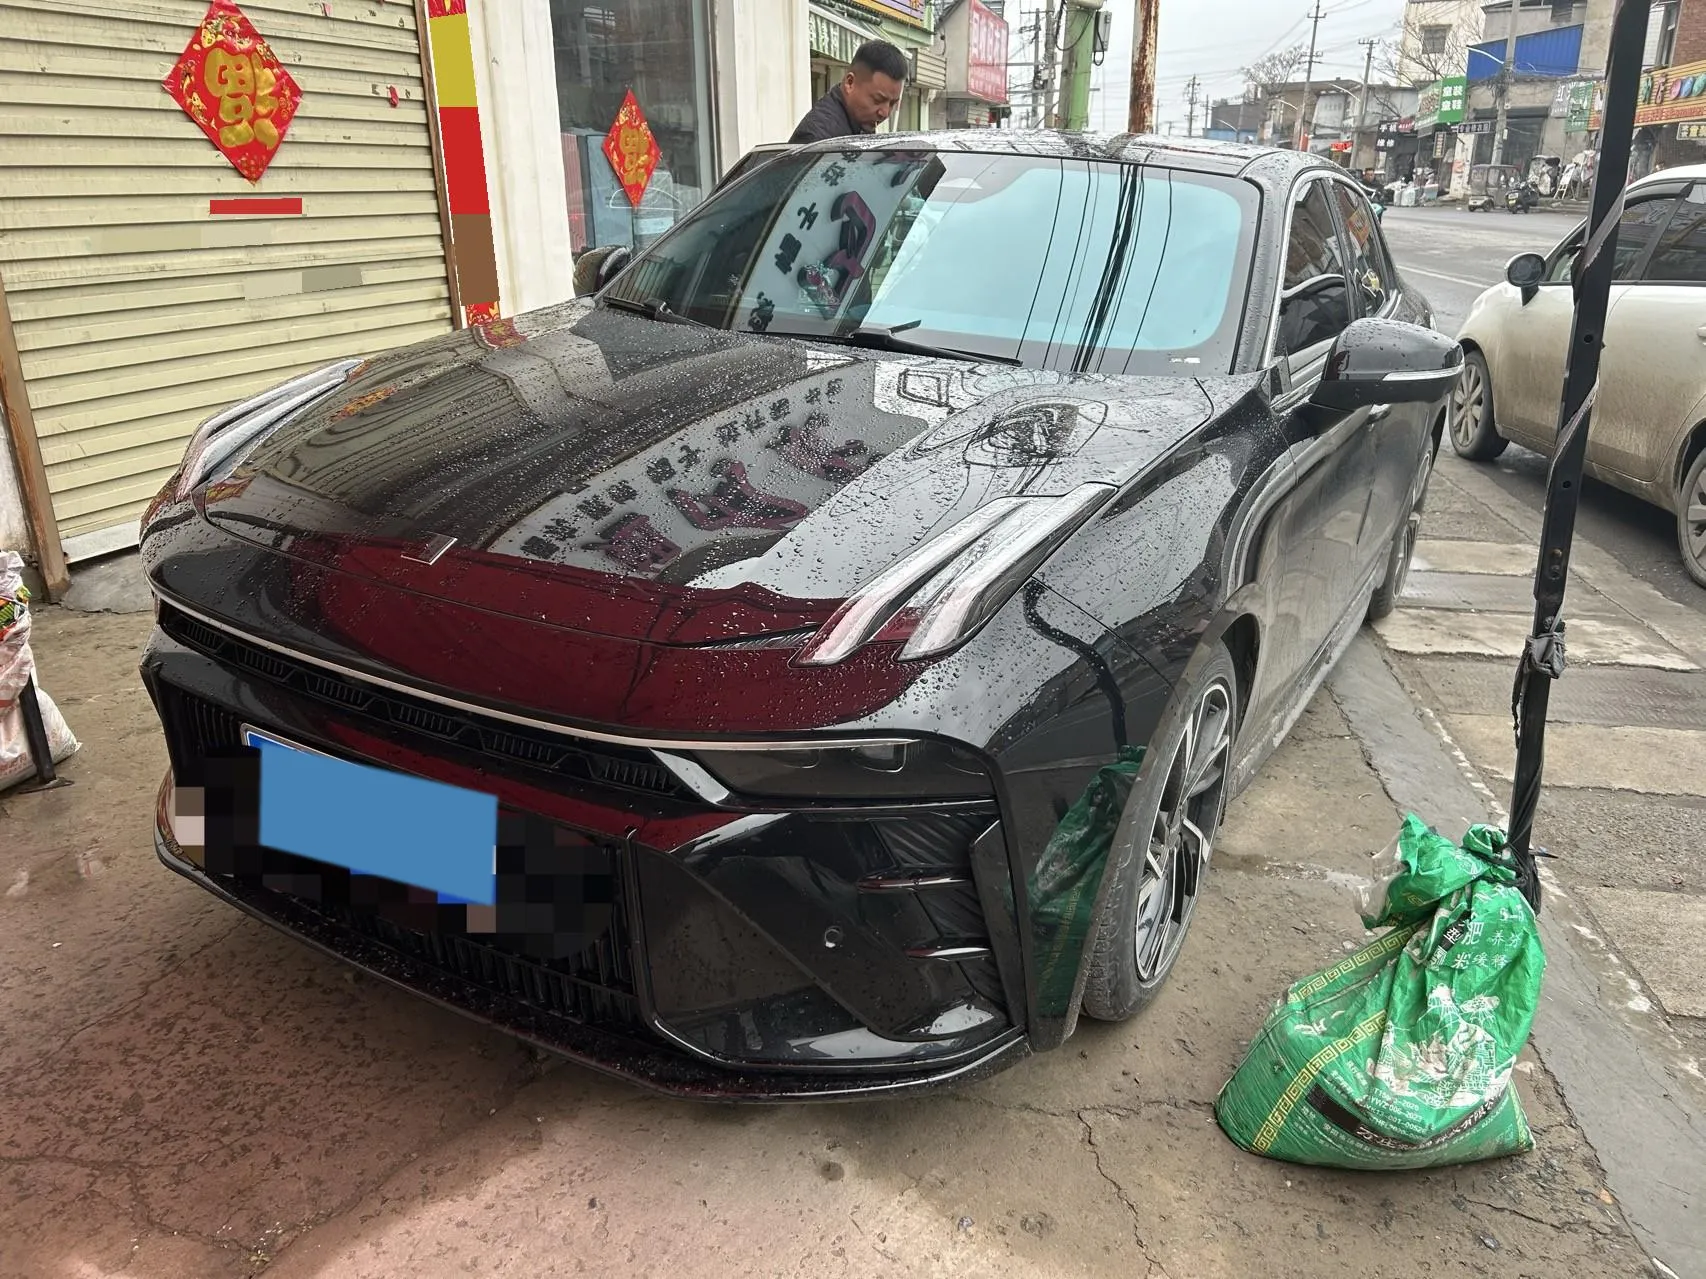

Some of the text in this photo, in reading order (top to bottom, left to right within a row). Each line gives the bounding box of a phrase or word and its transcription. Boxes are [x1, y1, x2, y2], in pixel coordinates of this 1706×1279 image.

[203, 47, 280, 151] 福
[1378, 123, 1398, 133] 手机
[1376, 138, 1395, 148] 维修
